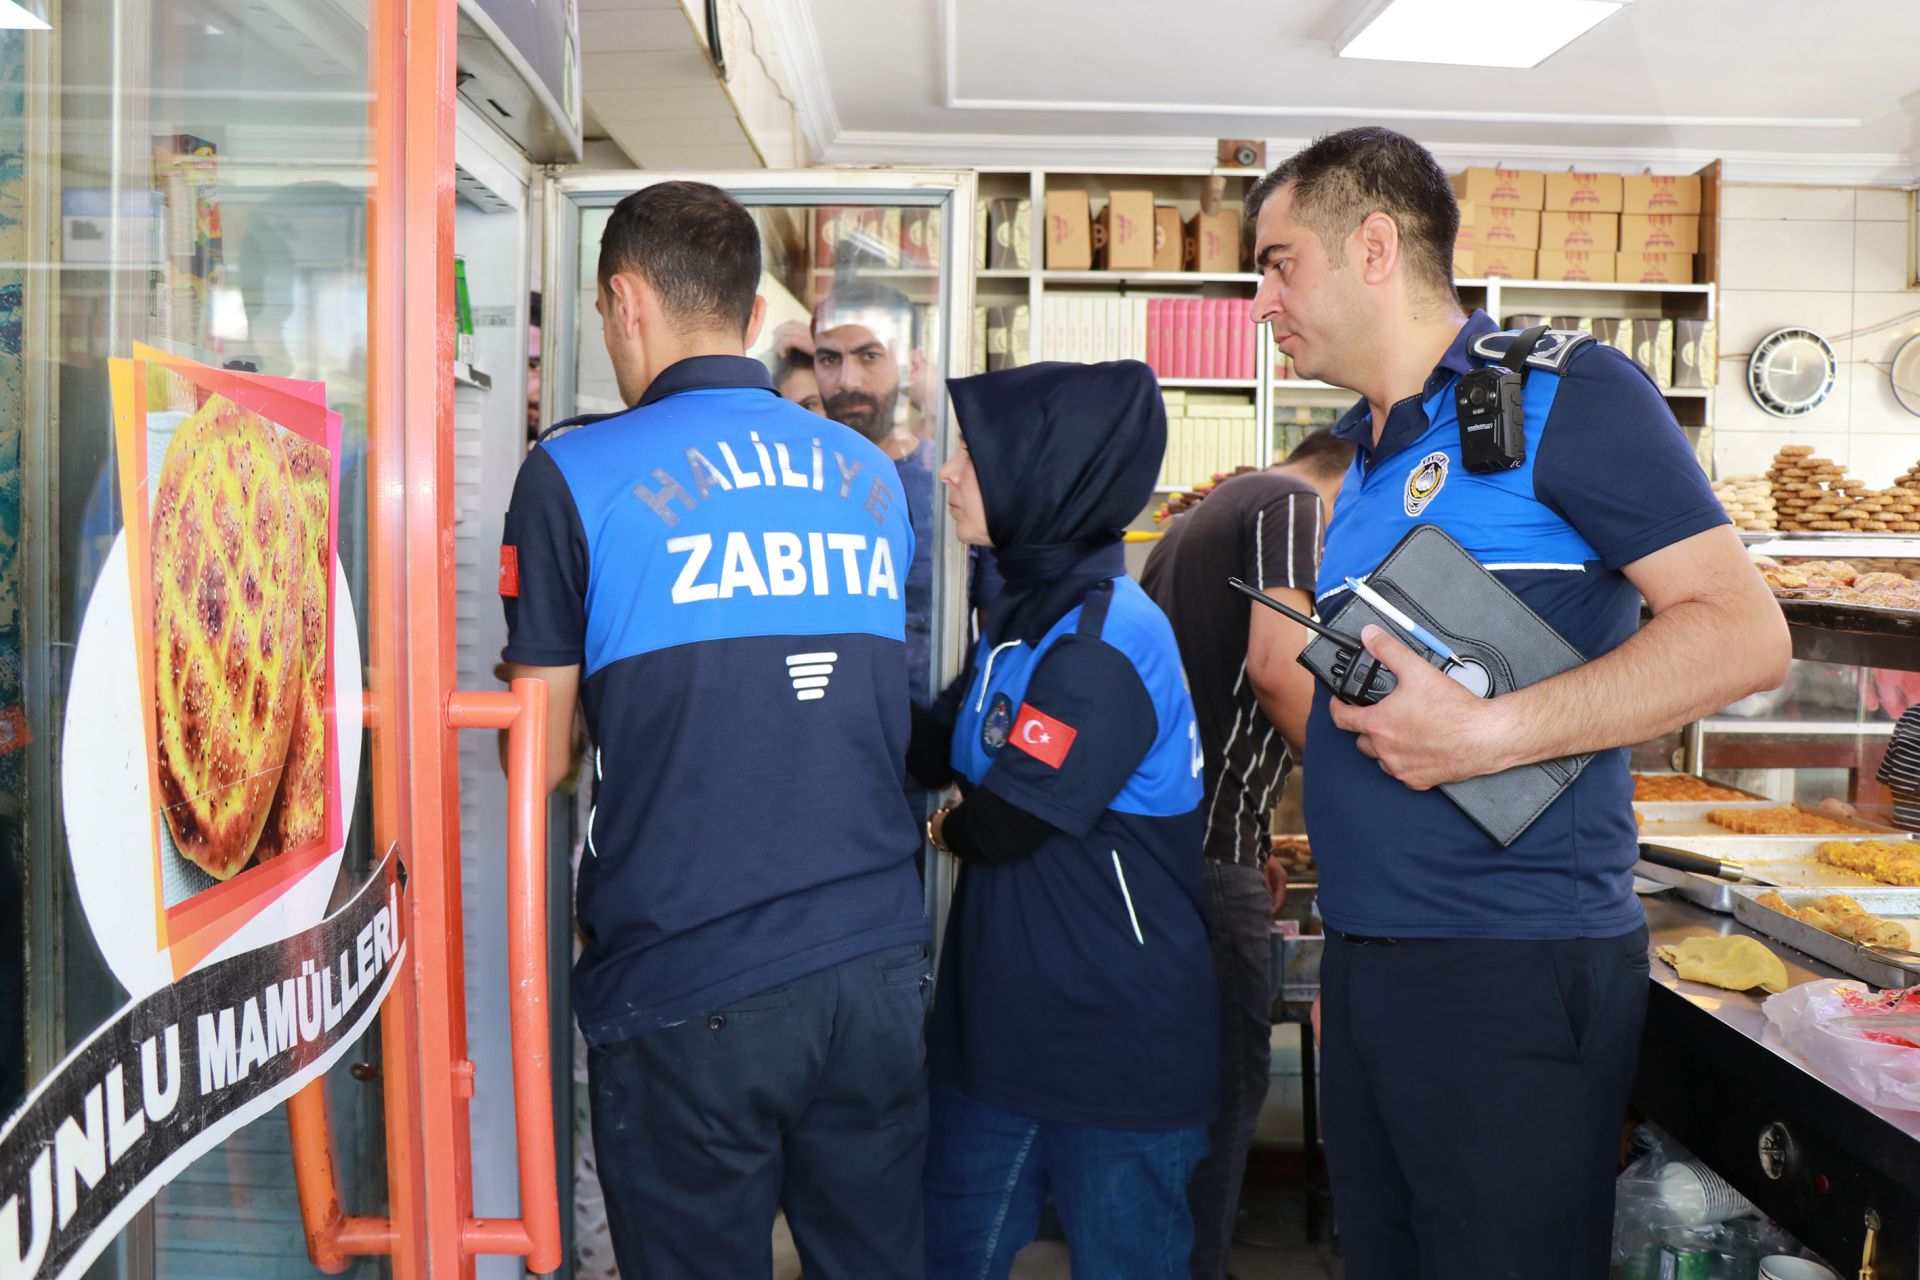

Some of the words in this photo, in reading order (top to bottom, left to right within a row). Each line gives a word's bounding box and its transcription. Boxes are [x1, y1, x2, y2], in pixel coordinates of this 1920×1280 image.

[633, 431, 893, 527] HALİLİYE
[666, 531, 899, 605] ZABITA
[0, 1023, 182, 1280] UNLU
[197, 882, 400, 1096] MAMÜLLERİ
